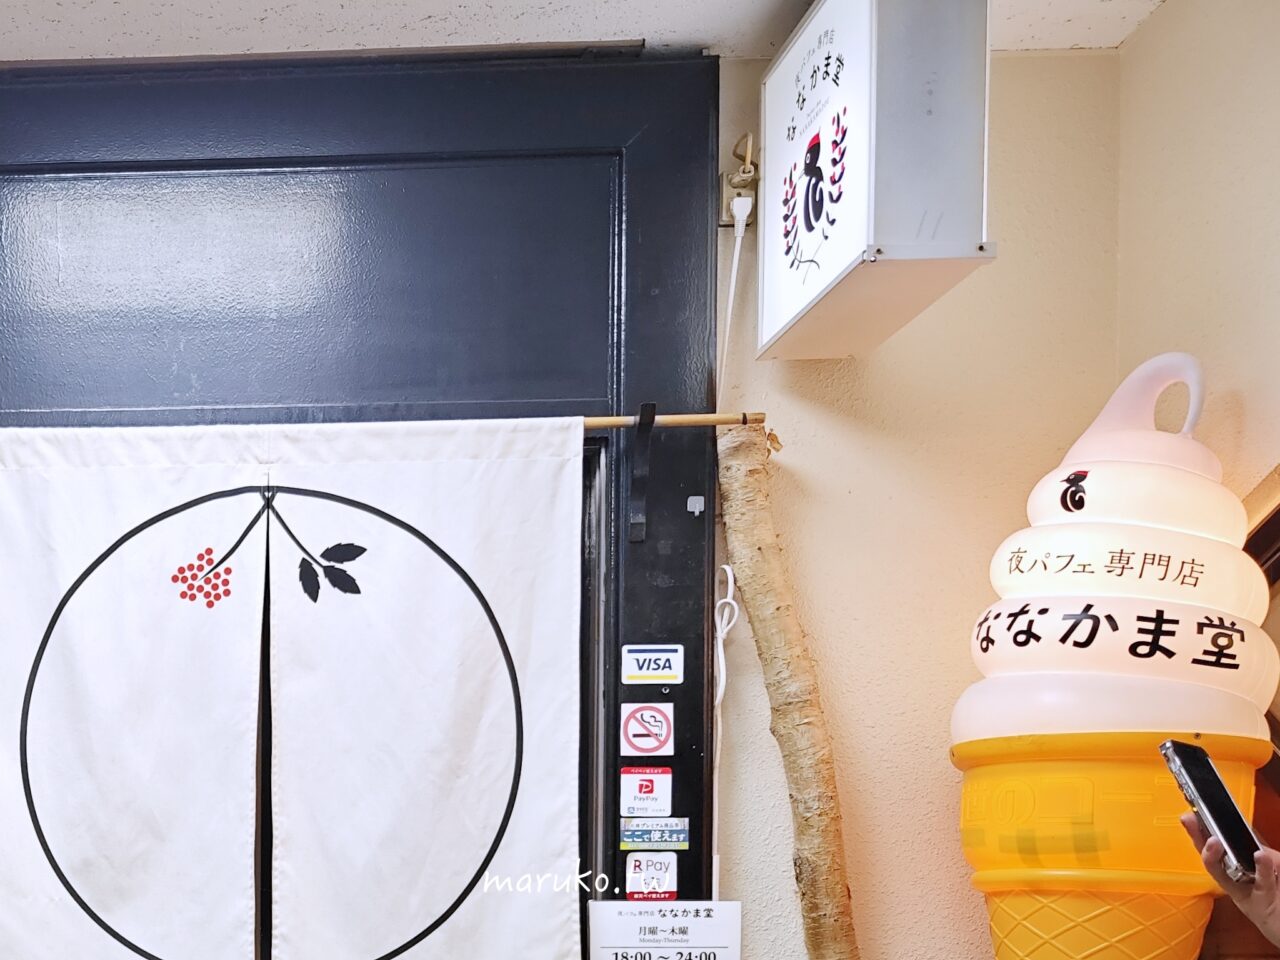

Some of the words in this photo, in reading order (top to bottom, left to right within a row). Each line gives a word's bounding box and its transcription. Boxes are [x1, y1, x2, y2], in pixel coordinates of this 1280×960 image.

[1007, 546, 1205, 588] 夜パフェ専門店
[975, 602, 1246, 670] ななかま堂
[634, 657, 672, 671] VISA
[623, 830, 687, 842] ここで使えます
[646, 859, 671, 873] Pay
[658, 908, 714, 918] ななかま堂
